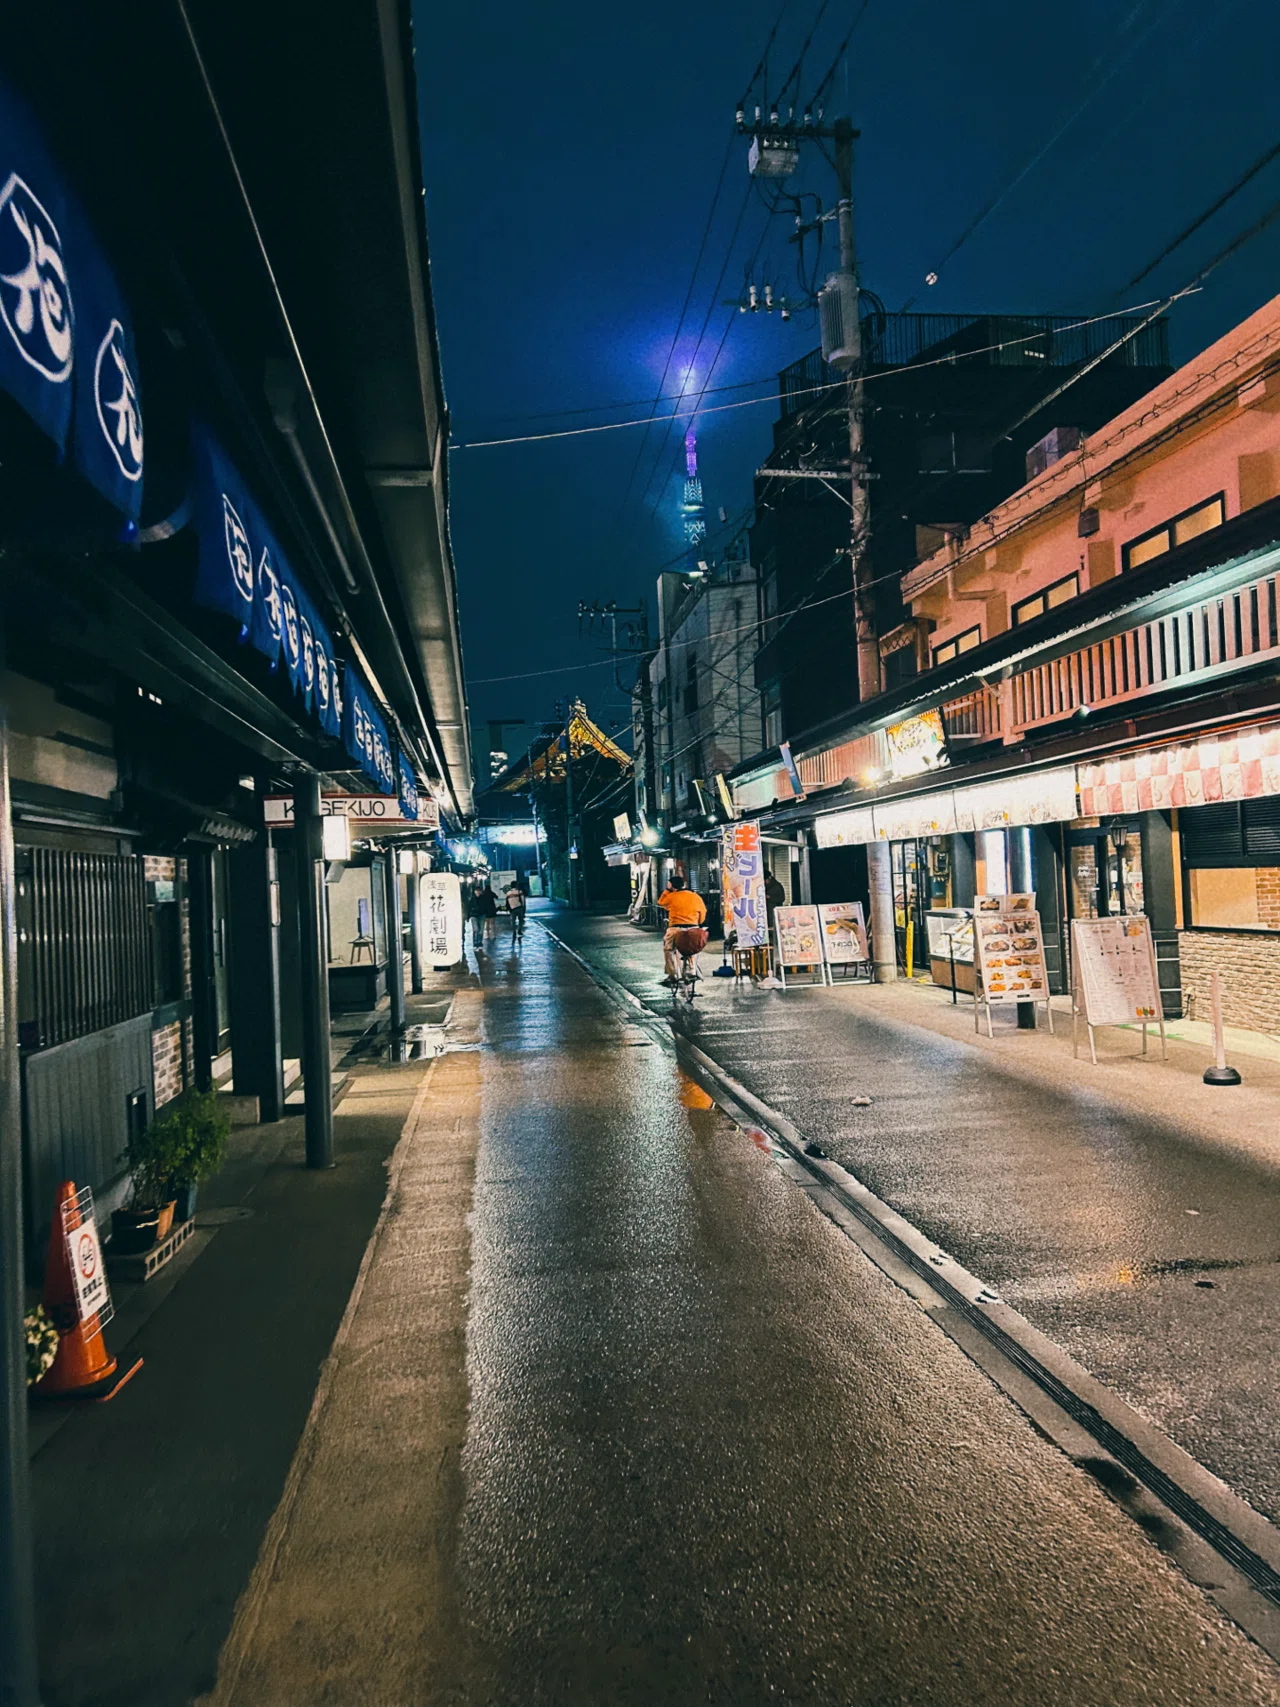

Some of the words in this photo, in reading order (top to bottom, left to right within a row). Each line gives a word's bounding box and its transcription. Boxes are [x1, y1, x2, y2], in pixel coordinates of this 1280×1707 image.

[283, 800, 386, 818] KGEKIJO
[429, 894, 448, 956] 花劇場
